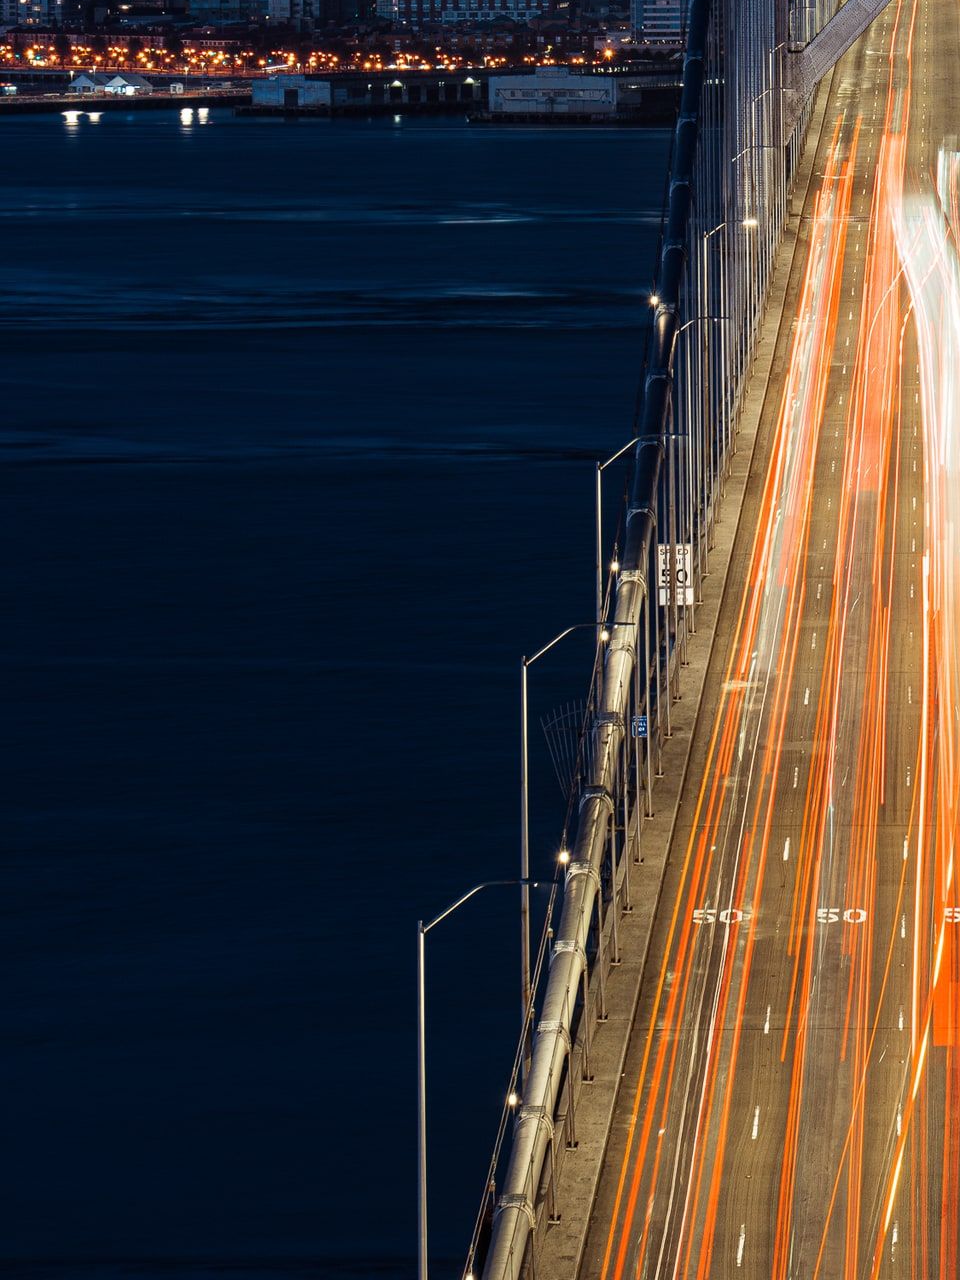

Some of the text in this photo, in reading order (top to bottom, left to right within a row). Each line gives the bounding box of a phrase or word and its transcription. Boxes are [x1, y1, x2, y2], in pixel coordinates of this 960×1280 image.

[662, 569, 688, 583] 50
[693, 908, 743, 924] 50
[817, 908, 867, 923] 50
